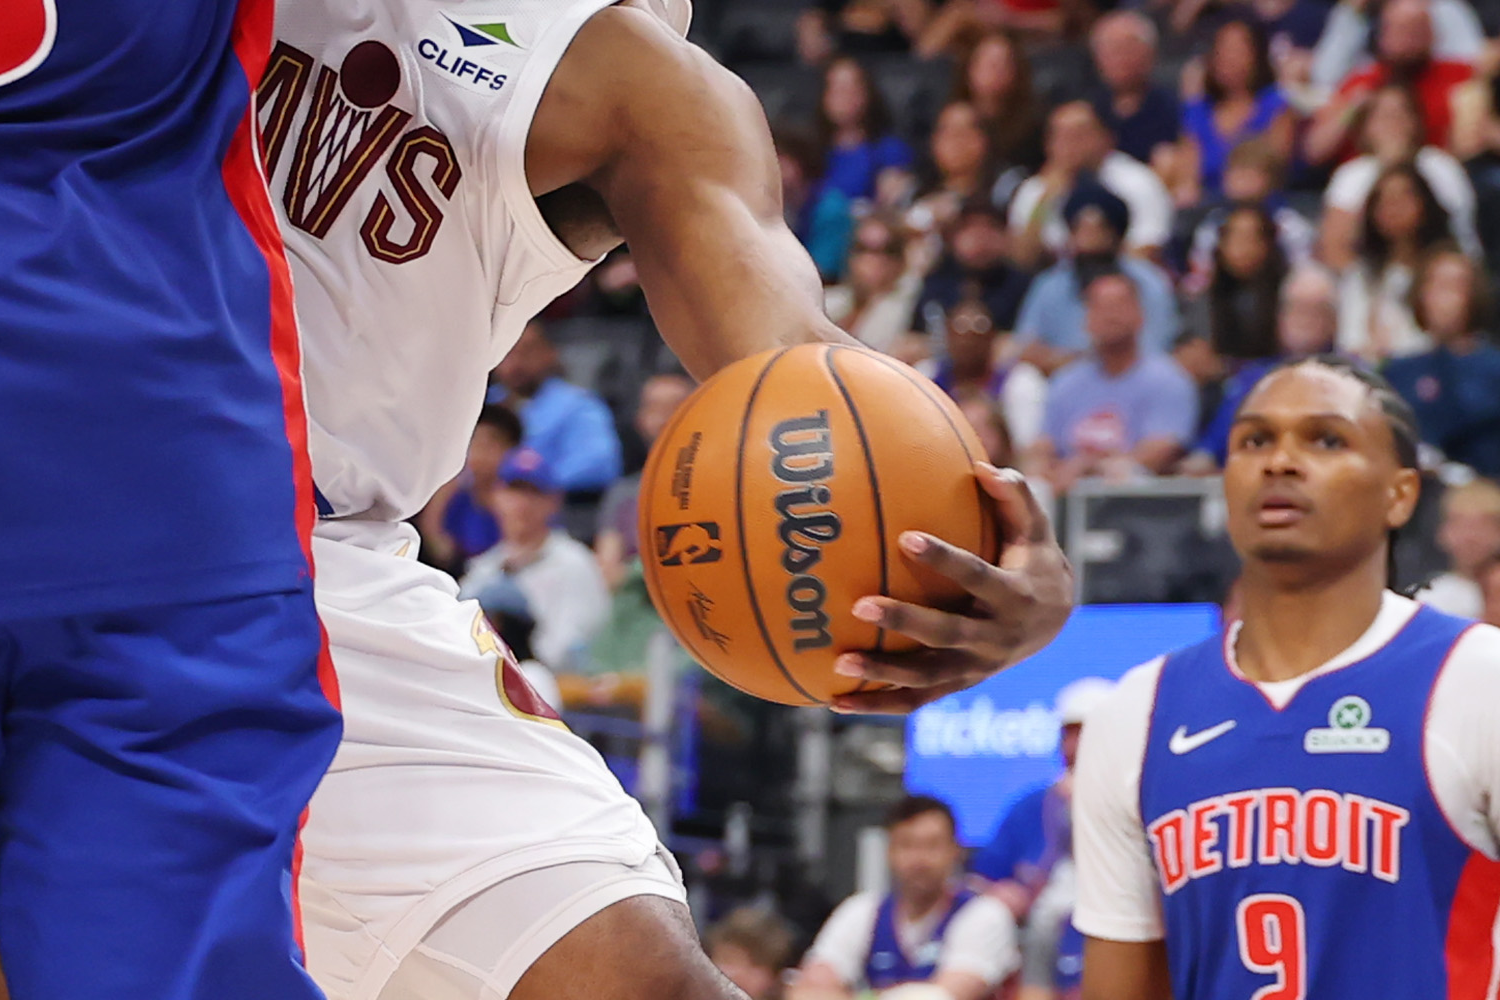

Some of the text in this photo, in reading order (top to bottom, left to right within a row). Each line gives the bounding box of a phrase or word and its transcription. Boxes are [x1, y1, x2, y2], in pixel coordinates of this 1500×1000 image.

[417, 38, 508, 91] CLIFFS
[767, 409, 842, 654] Wilson
[1148, 788, 1409, 894] DETROIT
[1237, 893, 1306, 1000] 9
